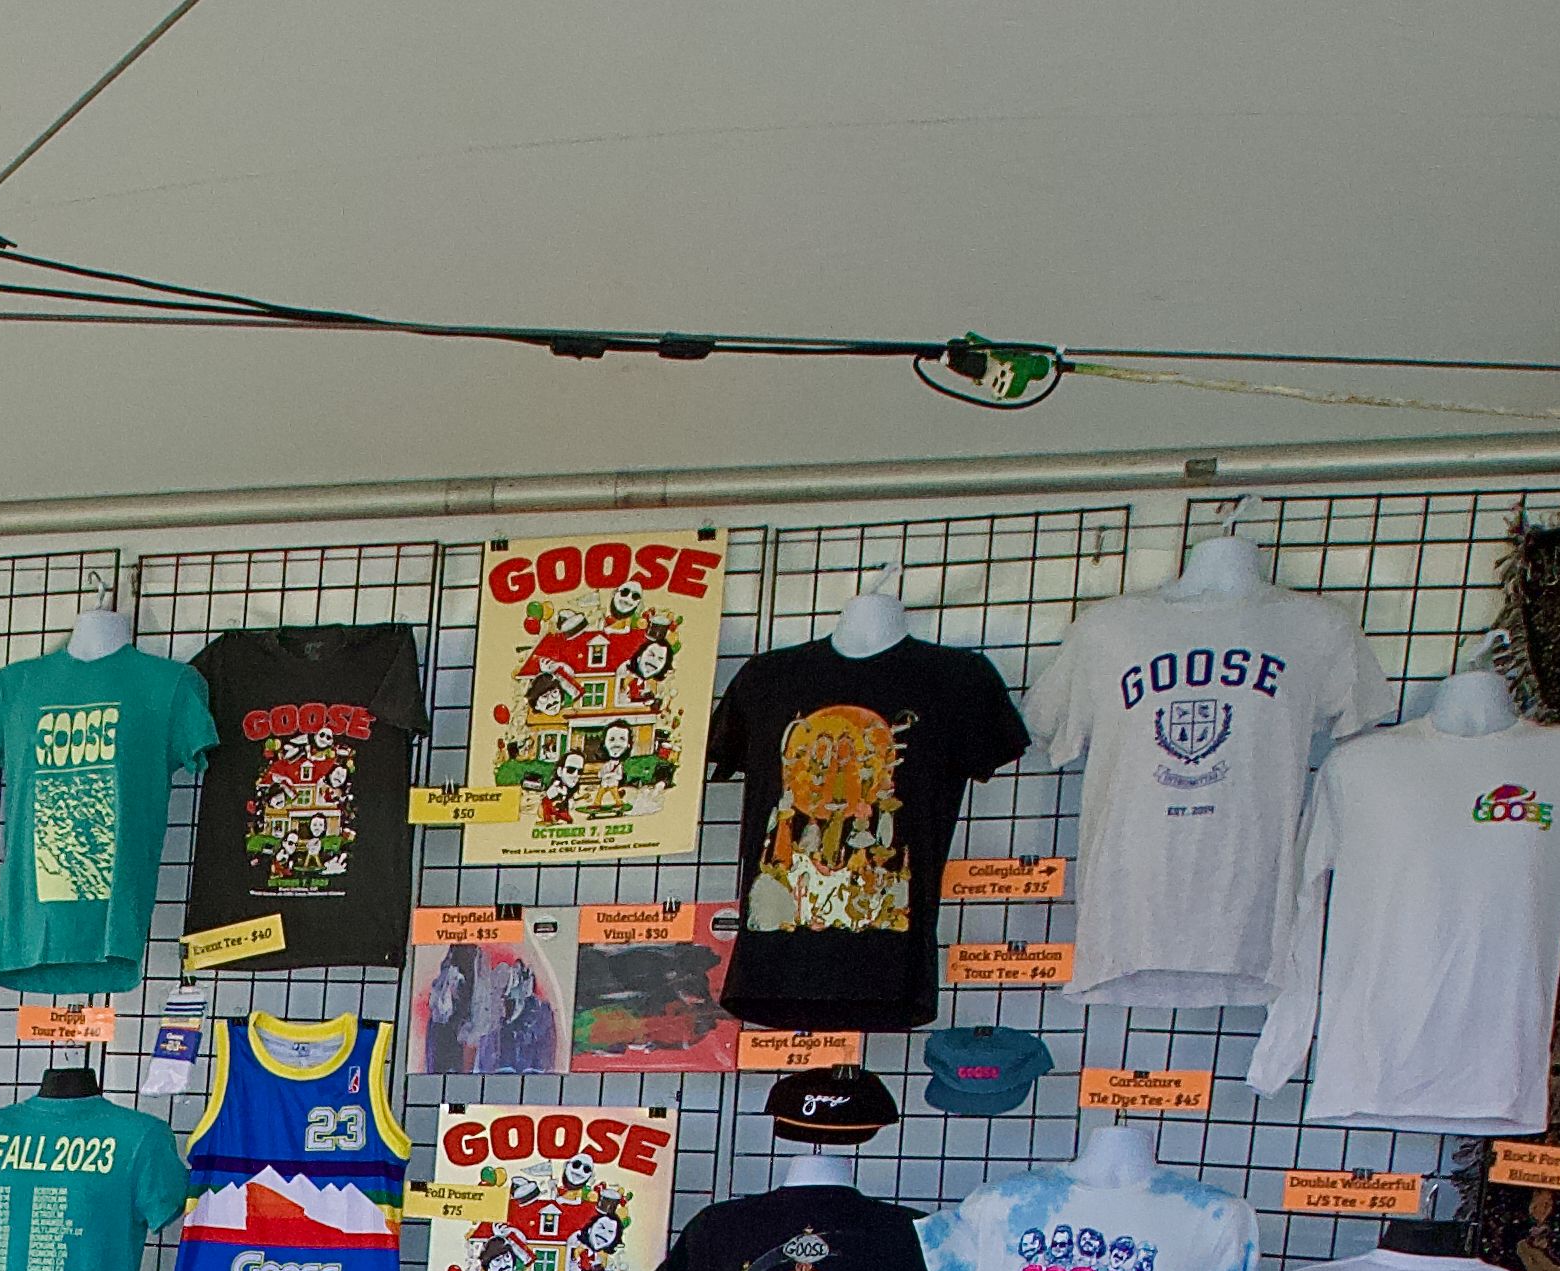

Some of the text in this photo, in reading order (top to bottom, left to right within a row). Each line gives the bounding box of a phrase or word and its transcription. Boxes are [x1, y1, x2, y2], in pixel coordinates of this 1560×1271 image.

[488, 542, 721, 604] GOOSE
[1120, 648, 1286, 711] GOOSE
[242, 703, 376, 741] GOOSE
[35, 707, 119, 767] GOOSE
[428, 791, 502, 804] Paper Poster
[453, 808, 475, 820] $50
[1472, 800, 1554, 831] GOOSE
[532, 824, 634, 839] OCTOBER 2023
[969, 864, 1033, 880] Collegiate
[953, 883, 988, 895] Crest
[990, 882, 1012, 895] Tee
[1023, 881, 1049, 895] $35
[442, 911, 494, 925] Dripfield
[597, 911, 659, 923] Undecided
[193, 938, 222, 956] Event
[223, 935, 243, 950] Tee
[251, 927, 273, 944] $40
[436, 928, 468, 942] Vinyl
[477, 927, 498, 940] $35
[603, 928, 636, 942] Vinyl
[645, 927, 668, 940] $30
[958, 949, 1062, 962] Rock Formation
[964, 967, 994, 980] Tour
[997, 967, 1019, 980] Tee
[1030, 966, 1056, 979] $40
[50, 1011, 86, 1025] Drippy
[31, 1026, 55, 1038] Tour
[57, 1026, 76, 1038] Tee
[751, 1036, 847, 1051] Script Logo Hat
[786, 1053, 810, 1066] $35
[1108, 1074, 1183, 1090] Caricature
[1087, 1092, 1109, 1106] Tie
[1111, 1093, 1137, 1109] Dye
[1139, 1093, 1162, 1107] Tee
[1173, 1093, 1201, 1107] $45
[304, 1105, 366, 1152] 23
[443, 1114, 671, 1177] GOOSE
[50, 1136, 116, 1174] 2023
[1501, 1149, 1536, 1165] Rock
[1289, 1175, 1417, 1192] Double Wonderful
[448, 1188, 484, 1201] Poster
[1306, 1193, 1330, 1209] L/S
[1332, 1194, 1356, 1208] Tee
[1367, 1194, 1397, 1209] $50
[442, 1204, 462, 1217] $75
[785, 1240, 828, 1258] GOOSE
